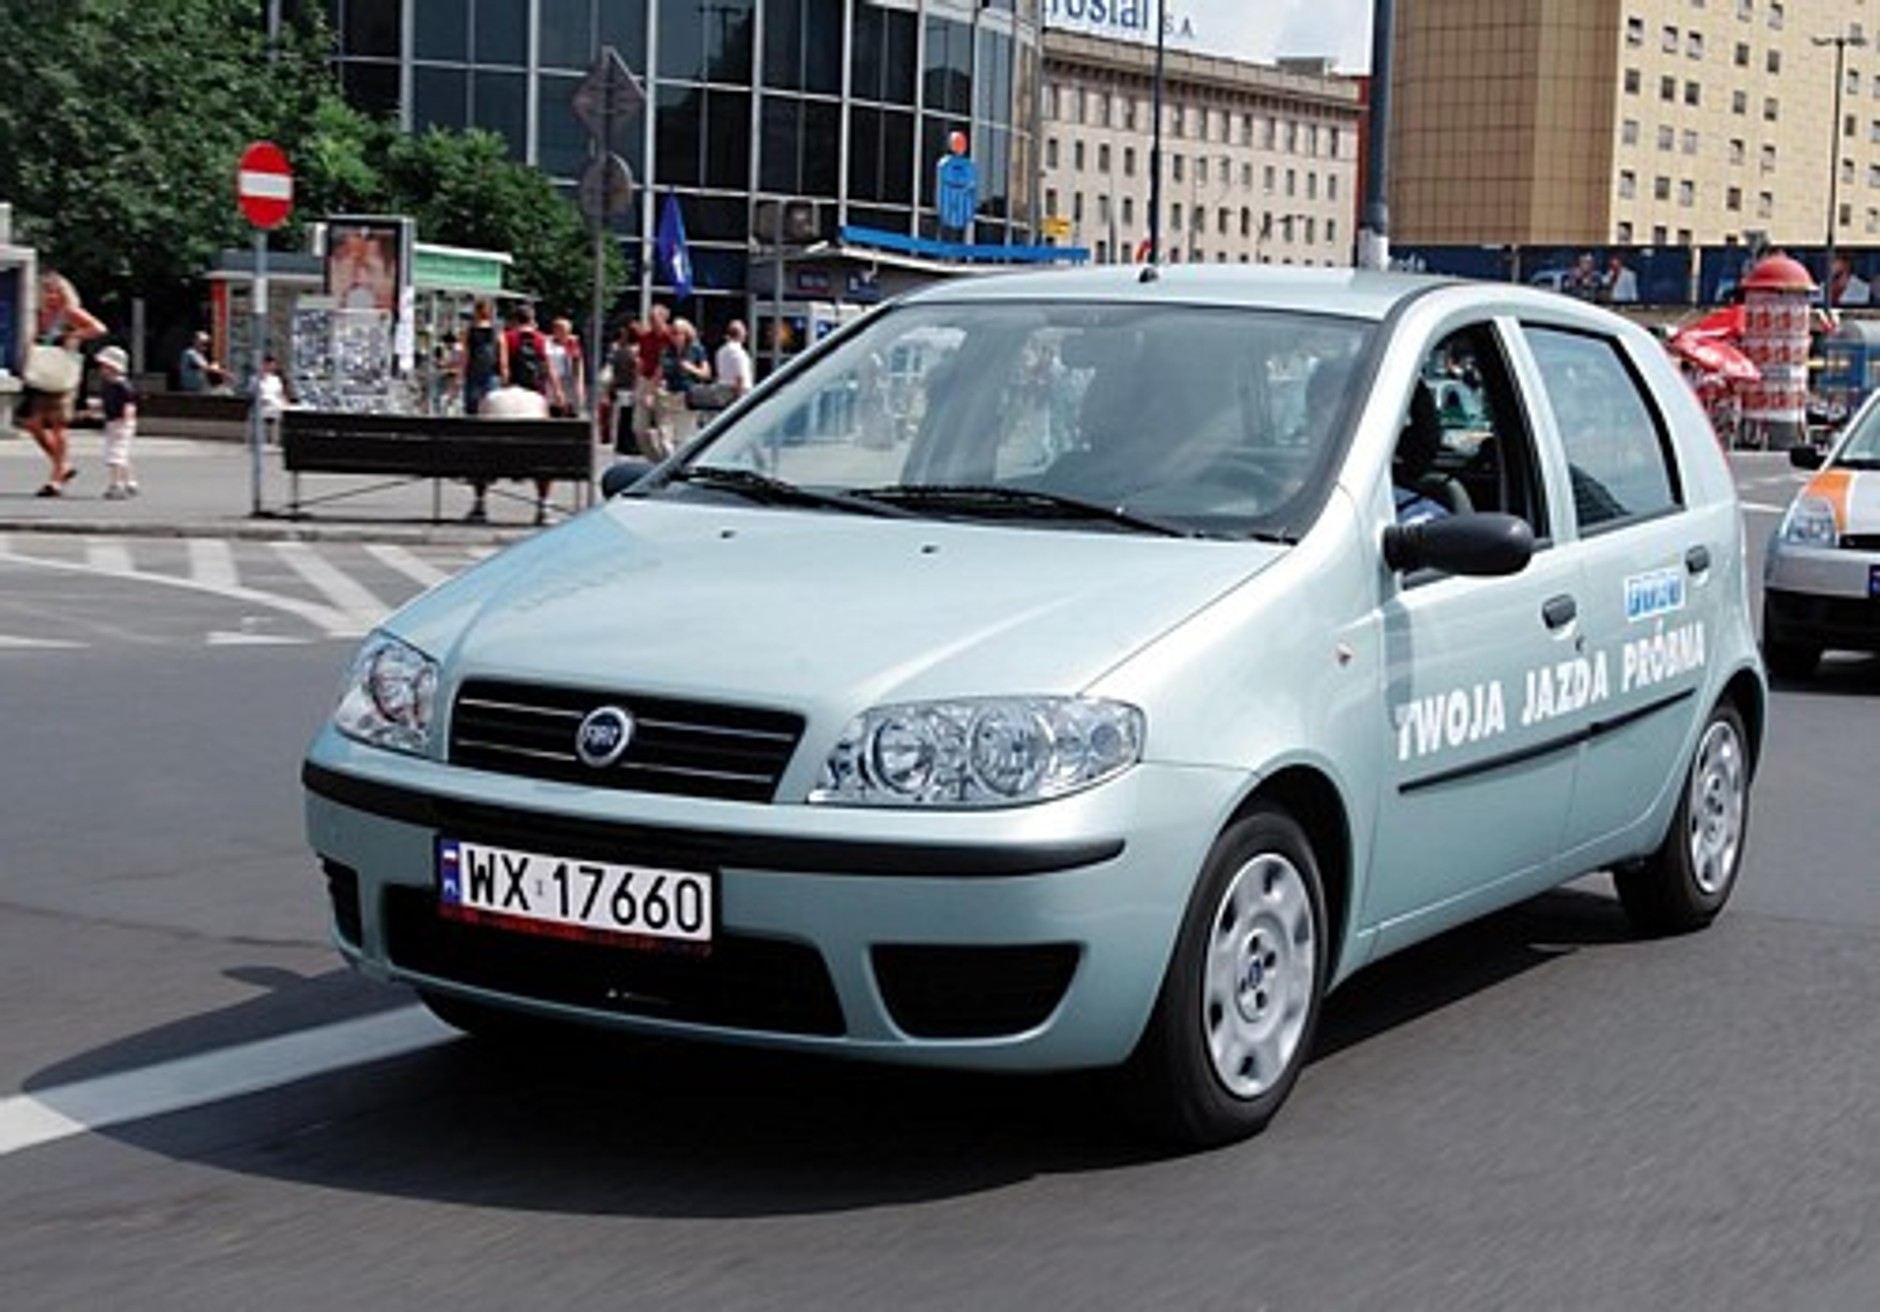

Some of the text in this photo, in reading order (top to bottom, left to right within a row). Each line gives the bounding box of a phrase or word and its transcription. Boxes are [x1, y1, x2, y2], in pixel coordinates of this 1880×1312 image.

[1395, 617, 1706, 761] TWOJA JAZDA PRÓBNA
[466, 849, 530, 911] WX
[553, 862, 704, 933] 17660
